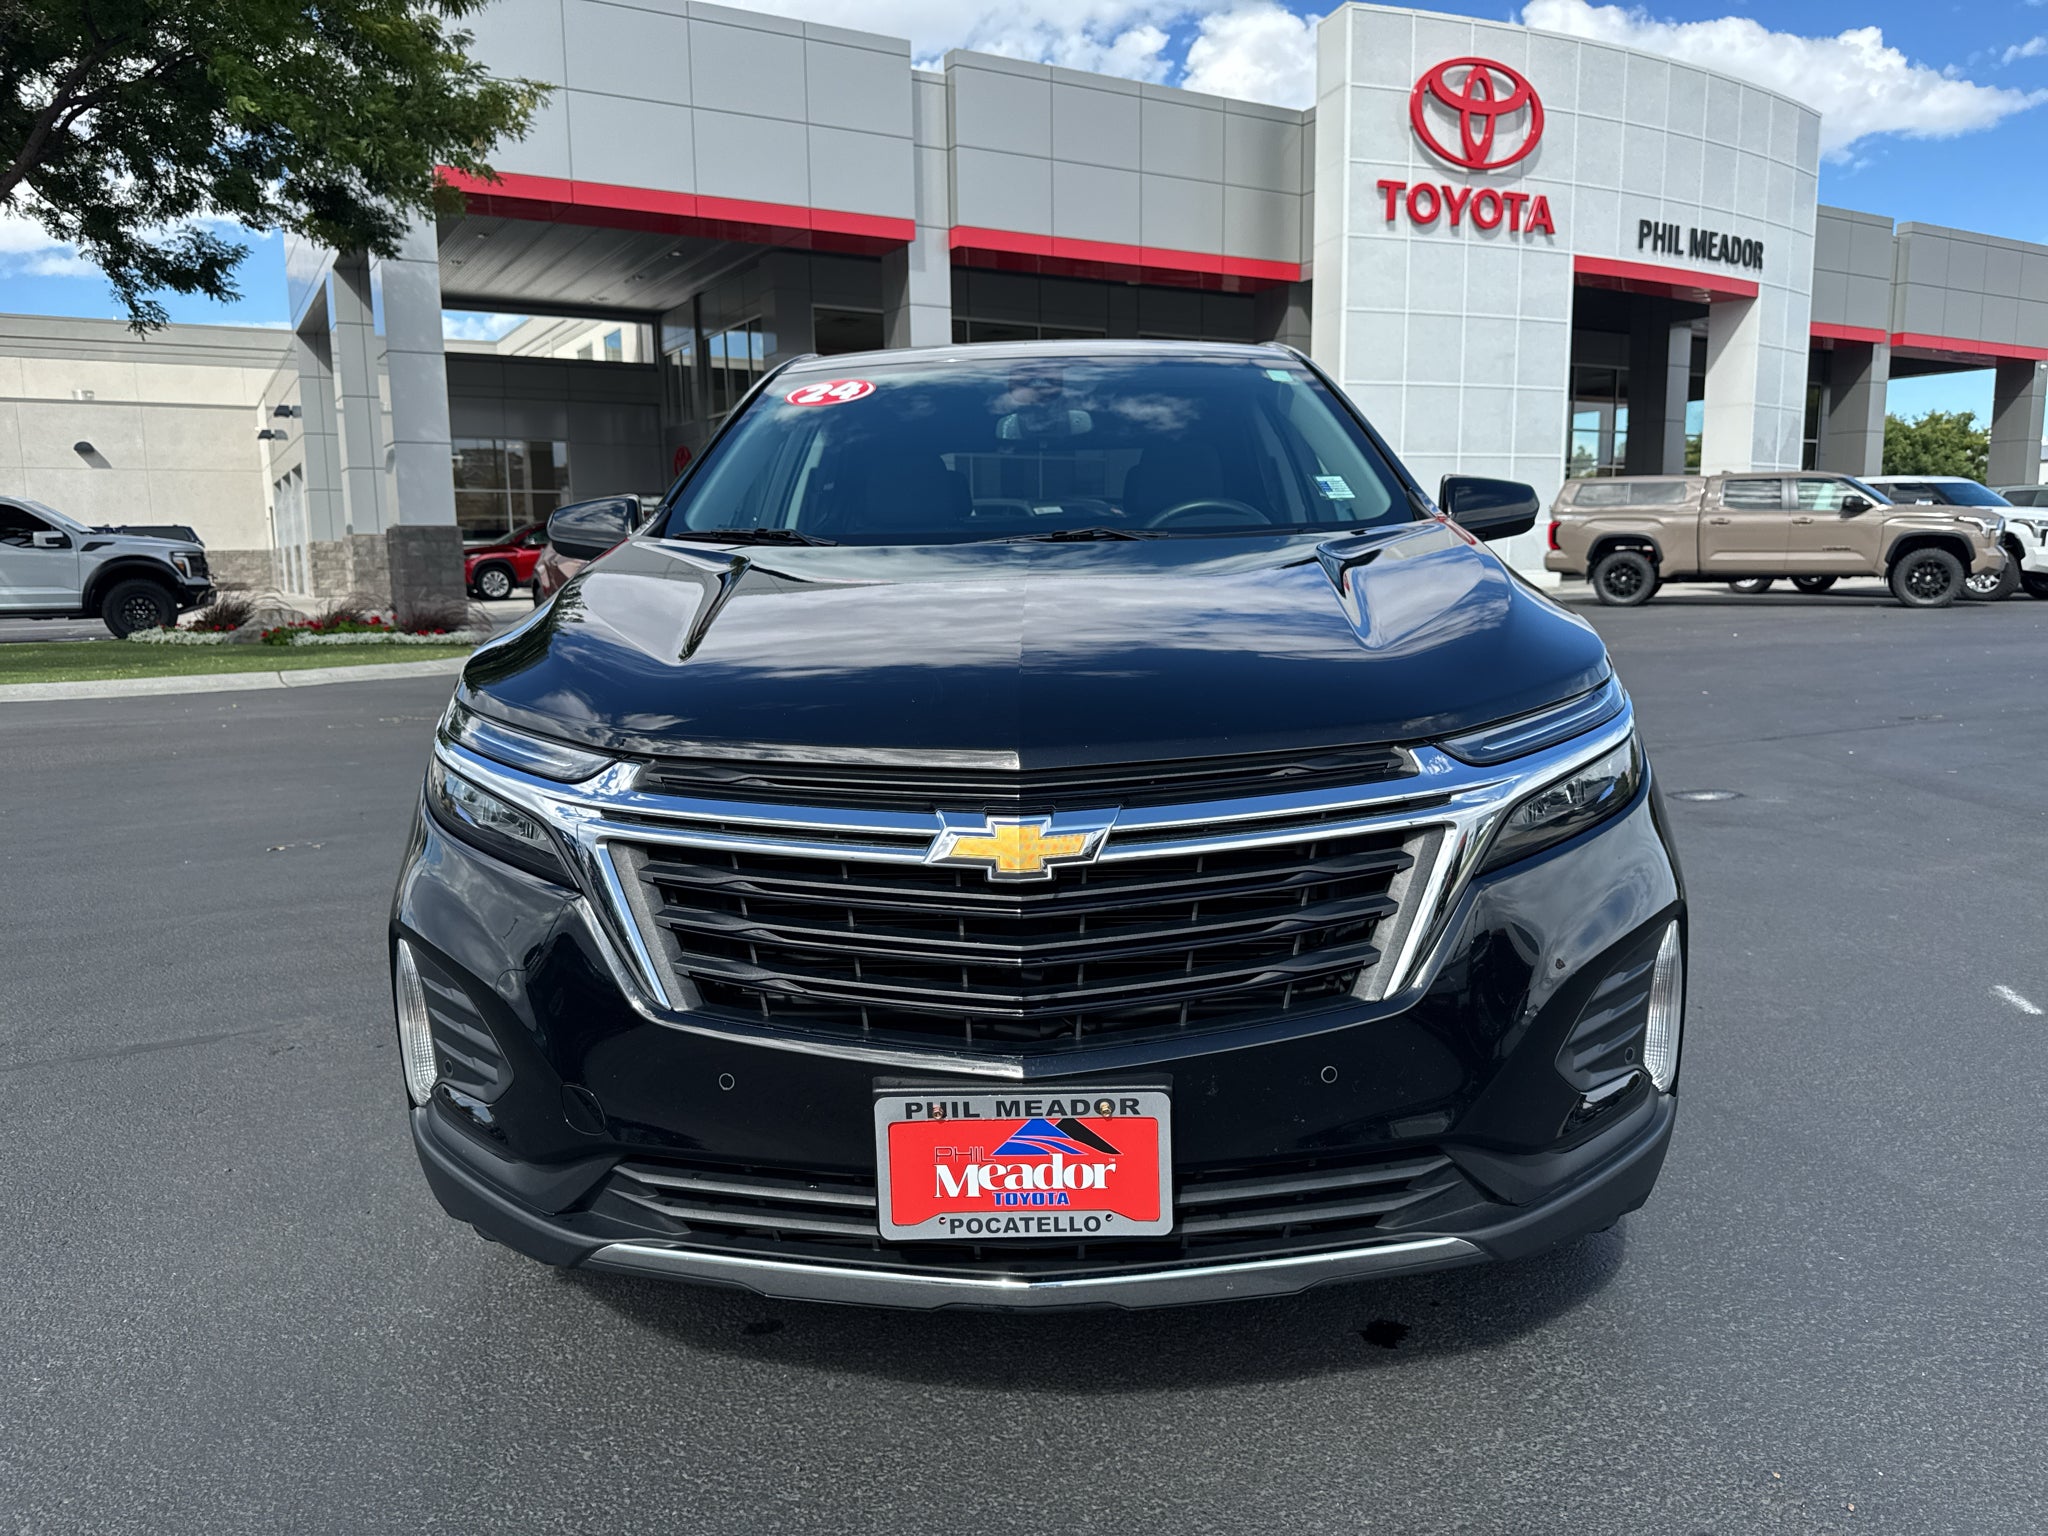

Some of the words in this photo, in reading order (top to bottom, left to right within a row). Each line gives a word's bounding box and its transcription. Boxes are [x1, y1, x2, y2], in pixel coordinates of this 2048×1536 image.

[1377, 180, 1555, 234] TOYOTA
[1639, 219, 1684, 256] PHIL
[1689, 229, 1764, 269] MEADOR
[797, 381, 863, 403] 24
[905, 1101, 980, 1119] PHIL
[995, 1098, 1141, 1117] MEADOR
[934, 1146, 996, 1162] PHIL
[933, 1153, 1116, 1198] Meador
[994, 1192, 1070, 1206] TOYOTA
[949, 1215, 1101, 1235] POCATELLO
